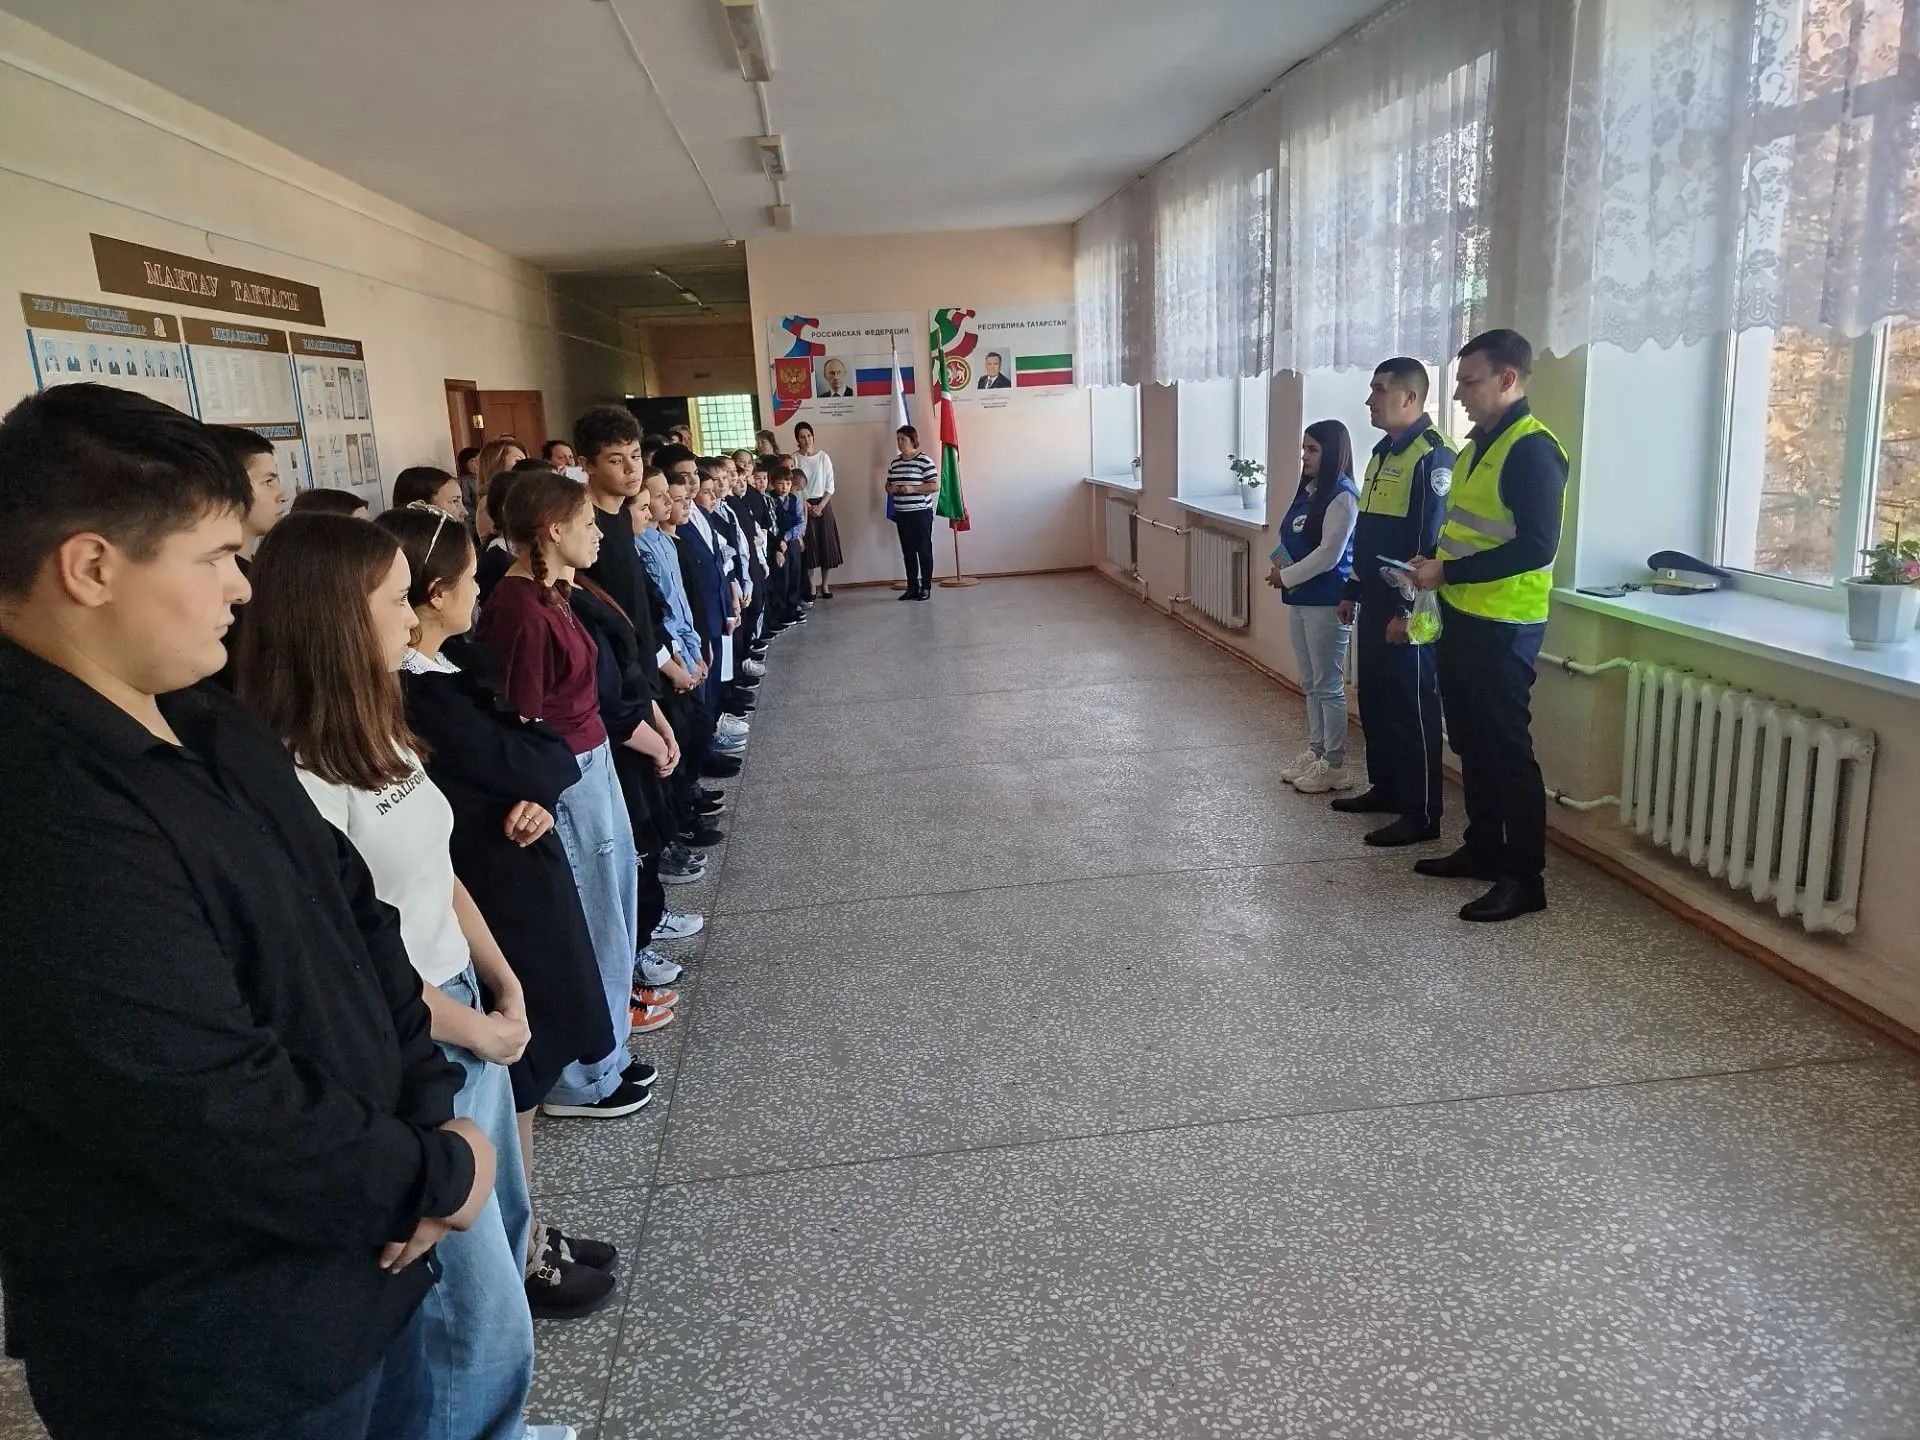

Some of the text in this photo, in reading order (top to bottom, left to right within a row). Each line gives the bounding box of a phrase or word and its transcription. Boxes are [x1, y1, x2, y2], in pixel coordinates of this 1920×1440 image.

[144, 261, 300, 311] МАКТАУ ТАКТАСЫ
[977, 319, 1067, 330] РЕСПУБЛИКА ТАТАРСТАН
[811, 327, 909, 338] РОССИЙСКАЯ ФЕДЕРАЦИЯ
[376, 799, 392, 815] IN
